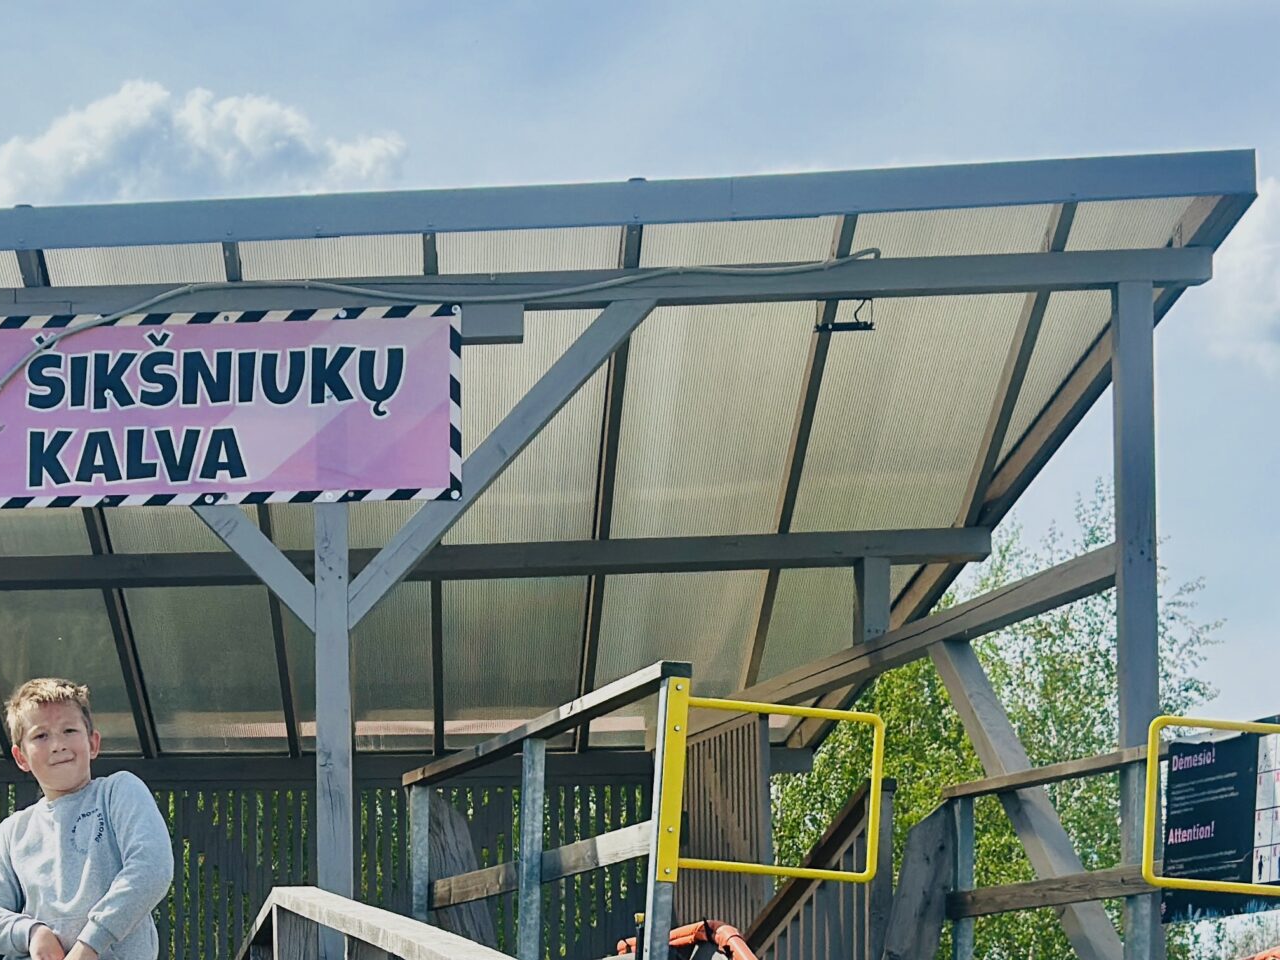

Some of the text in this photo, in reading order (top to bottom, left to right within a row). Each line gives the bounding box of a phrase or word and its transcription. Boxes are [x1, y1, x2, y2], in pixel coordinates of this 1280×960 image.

[26, 331, 404, 417] ŠIKŠNIUKŲ
[28, 427, 248, 488] KALVA
[1171, 746, 1216, 772] Dėmesio!
[1167, 820, 1215, 845] Attention!
